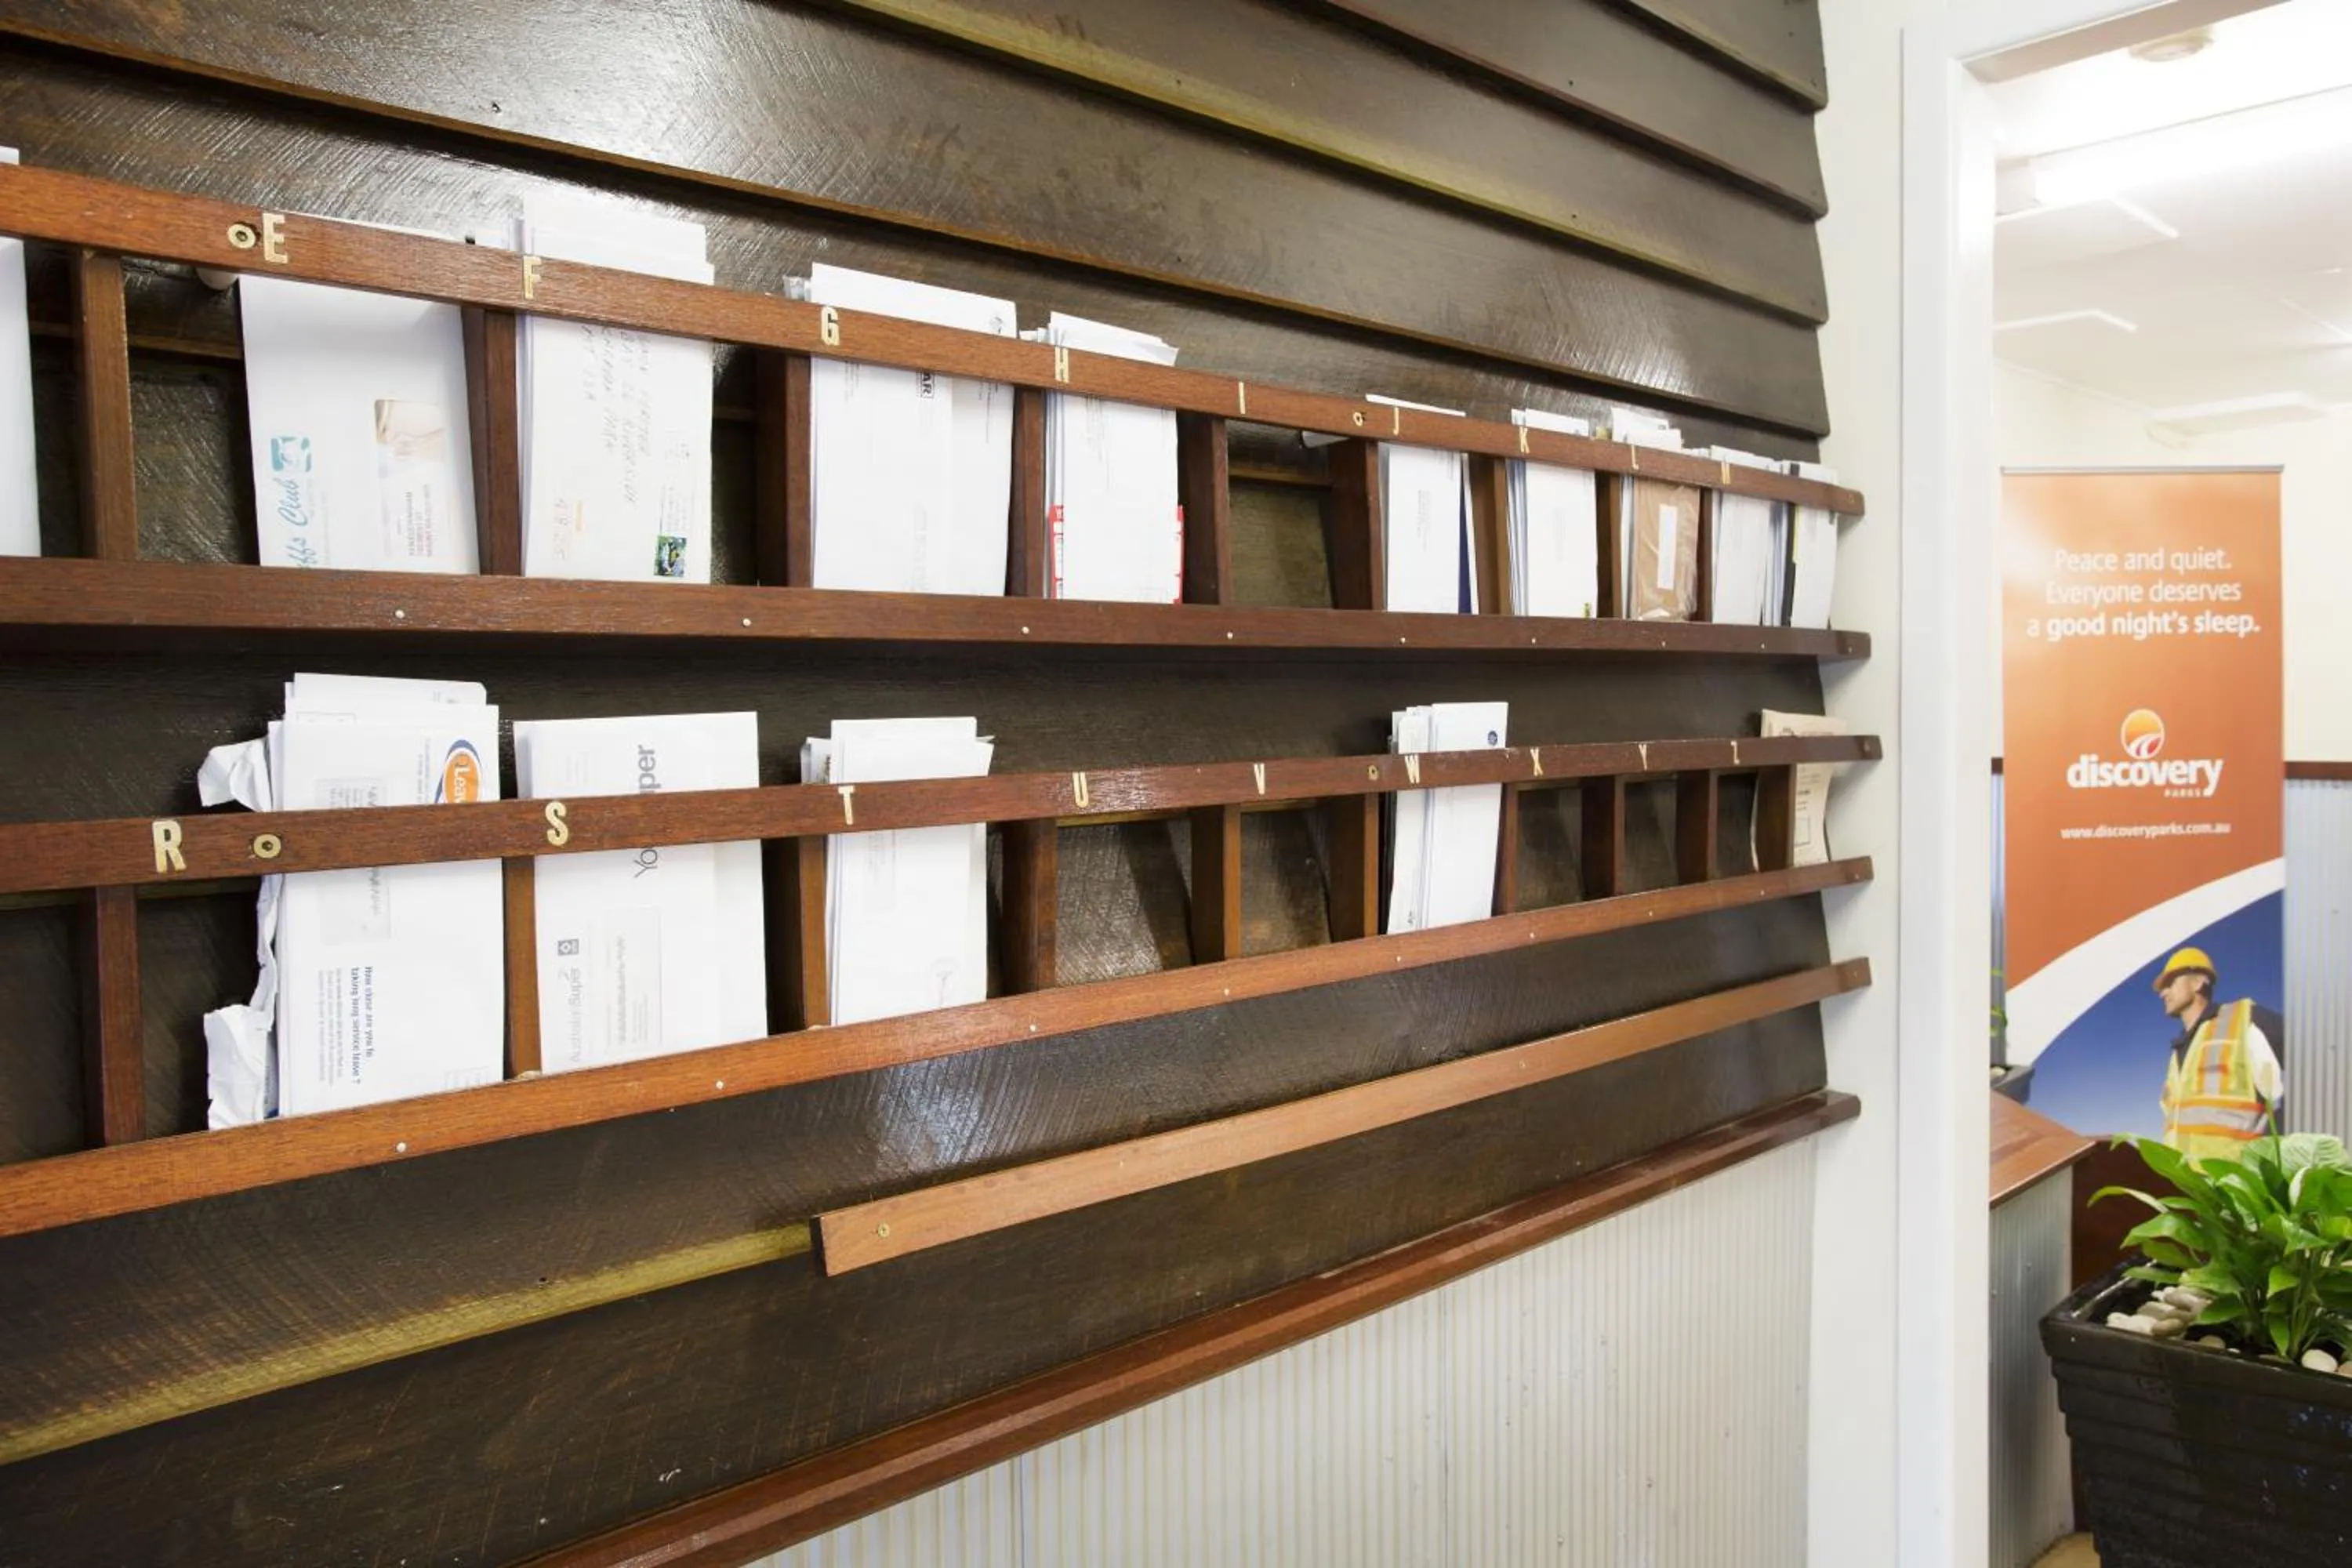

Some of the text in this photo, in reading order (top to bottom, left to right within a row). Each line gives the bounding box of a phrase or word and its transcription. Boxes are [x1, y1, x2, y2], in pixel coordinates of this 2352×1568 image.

[262, 212, 289, 264] E
[522, 256, 541, 299] F
[820, 306, 840, 346] G
[1054, 347, 1069, 383] H
[1238, 381, 1246, 414] I
[1392, 406, 1400, 435] J
[1519, 426, 1530, 453] K
[1631, 445, 1639, 470] L
[272, 477, 309, 526] Club
[2055, 546, 2233, 575] Peace and quiet.
[2045, 579, 2242, 609] Everyone deserves
[2027, 609, 2262, 642] a good night's sleep.
[1403, 754, 1421, 784] W
[1530, 748, 1544, 776] X
[1638, 743, 1648, 771] Y
[1731, 740, 1740, 765] Z
[1072, 771, 1089, 808] U
[1254, 763, 1265, 795] V
[2067, 754, 2224, 797] discovery
[837, 785, 857, 826] T
[545, 800, 570, 847] S
[2060, 823, 2232, 840] www.discoveryparks.com.au
[152, 818, 187, 874] R
